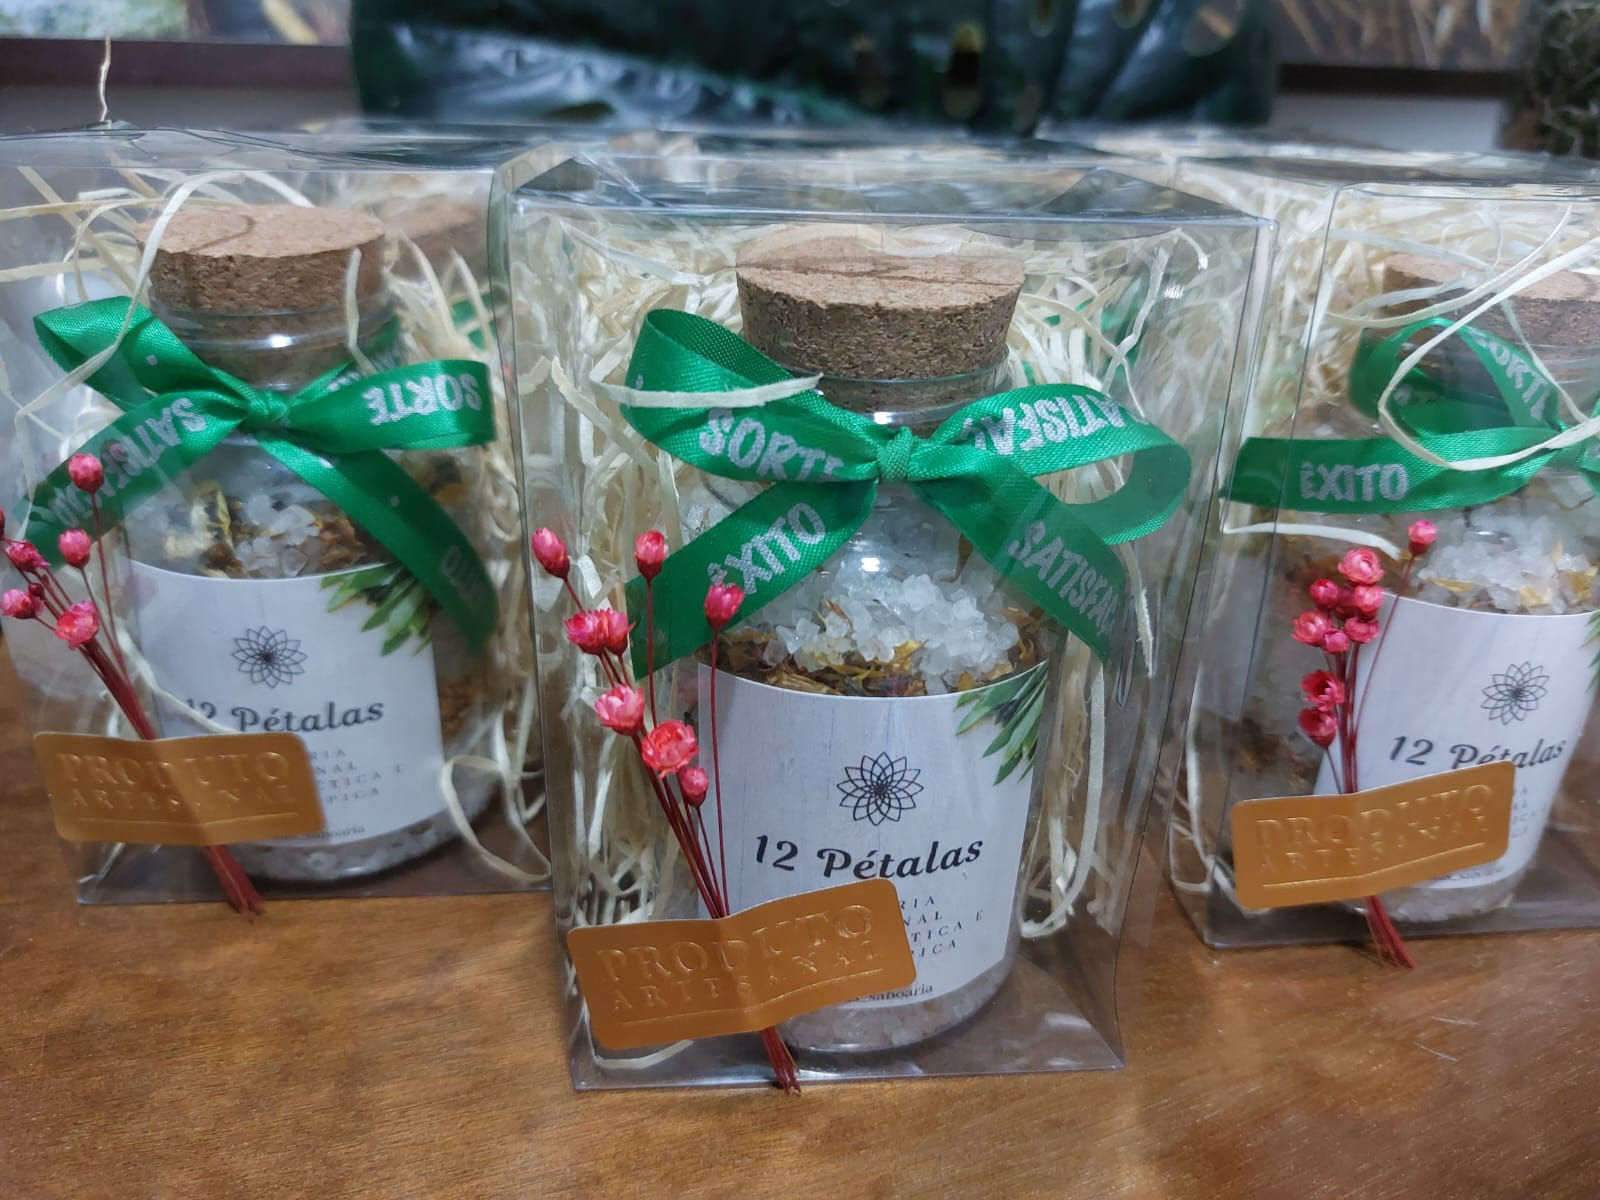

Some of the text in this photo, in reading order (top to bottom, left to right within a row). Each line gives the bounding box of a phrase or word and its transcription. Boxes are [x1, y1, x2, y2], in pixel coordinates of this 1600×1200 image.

[362, 373, 482, 425] SORTE
[964, 394, 1126, 455] ATISFA
[231, 701, 384, 732] Pétalas
[1390, 736, 1434, 765] 12
[756, 835, 984, 879] 12 Pétalas
[597, 903, 873, 982] PRODUTO
